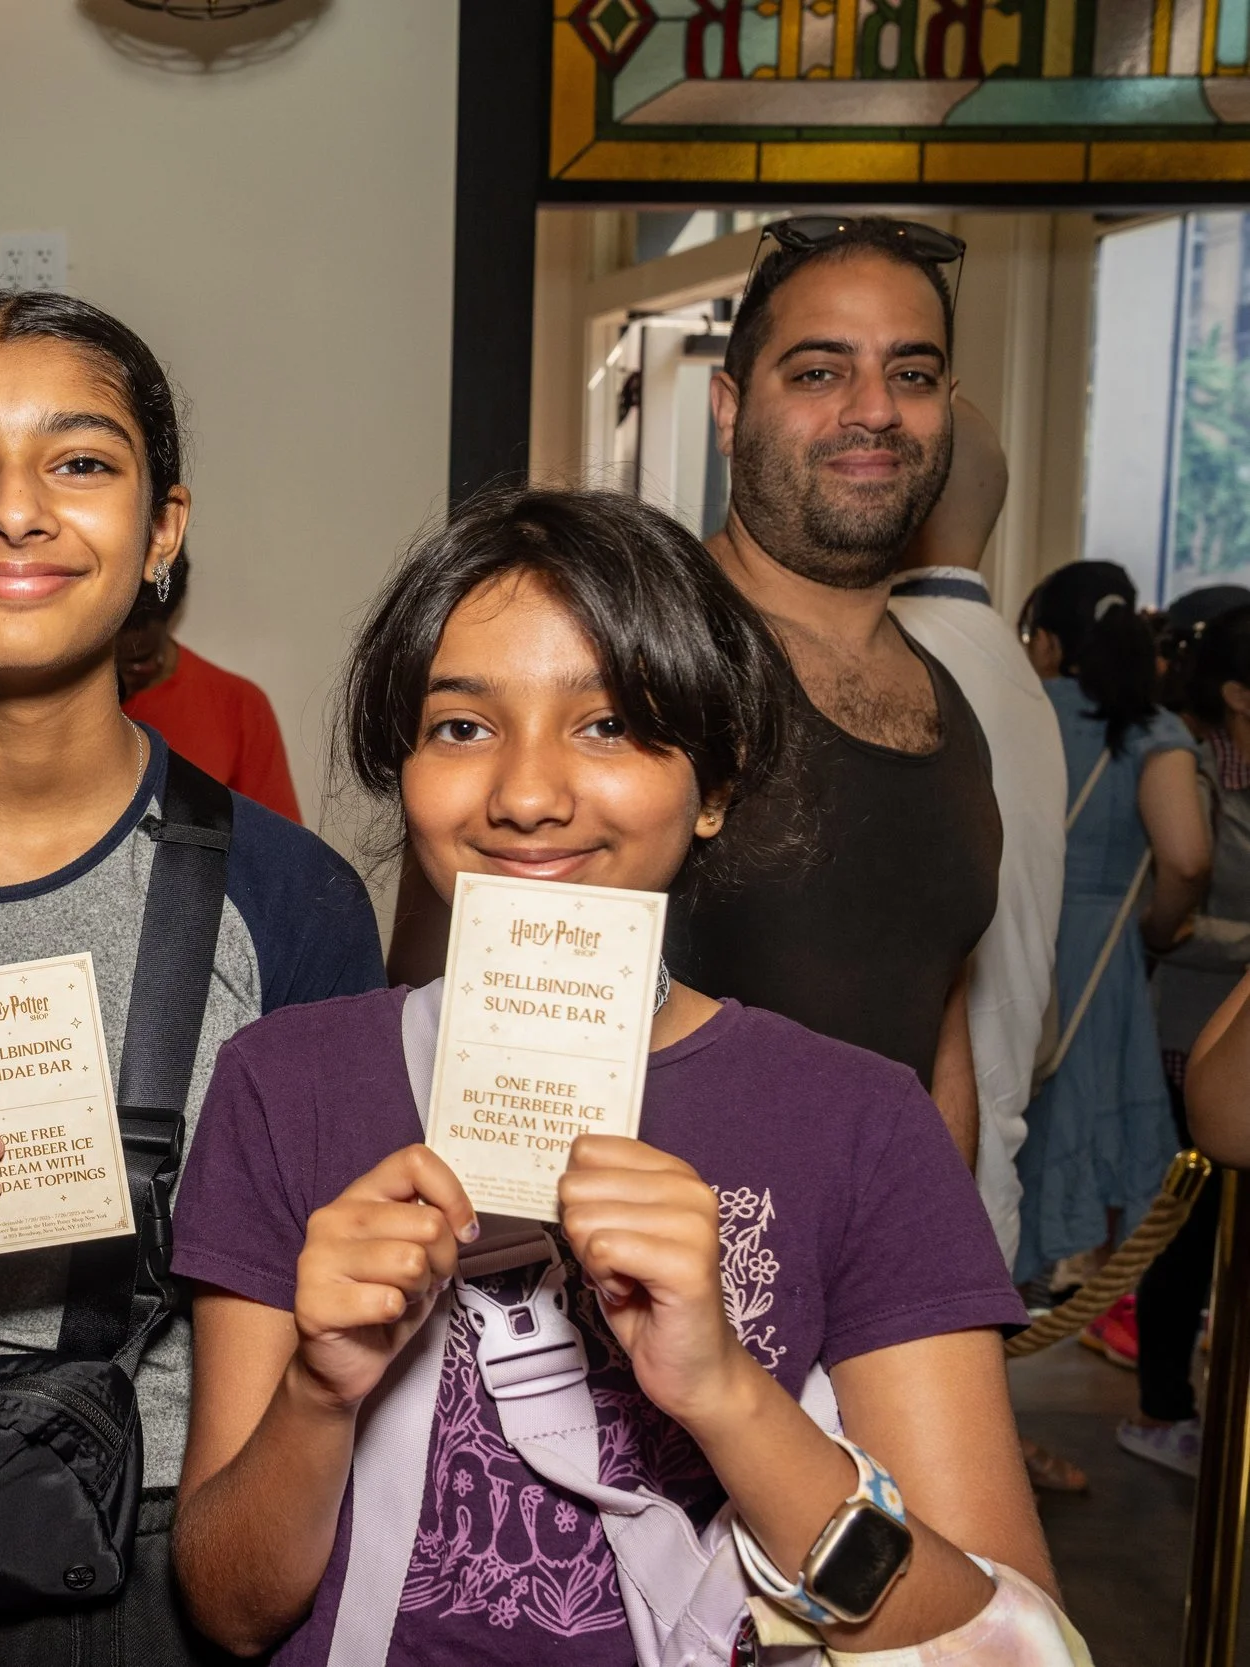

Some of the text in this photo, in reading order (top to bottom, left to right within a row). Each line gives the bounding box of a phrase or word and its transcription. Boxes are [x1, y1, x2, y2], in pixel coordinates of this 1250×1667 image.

[510, 919, 601, 949] Harry Potter
[574, 949, 596, 957] SHOP
[483, 971, 613, 1000] SPELLBINDING
[10, 996, 50, 1021] Potter
[30, 1013, 48, 1021] SHOP
[484, 996, 605, 1024] SUNDAE BAR
[39, 1059, 72, 1075] BAR
[495, 1075, 576, 1097] ONE FREE
[463, 1089, 605, 1120] BUTTERBEER ICE
[473, 1110, 589, 1136] CREAM WITH
[0, 1125, 66, 1146] ONE FREE
[450, 1125, 570, 1154] SUNDAE TOPP
[5, 1137, 93, 1160] TERBEER ICE
[46, 1154, 84, 1170] WITH
[2, 1167, 106, 1193] DAE TOPPINGS
[42, 1220, 56, 1229] Harry
[72, 1216, 85, 1224] Shop
